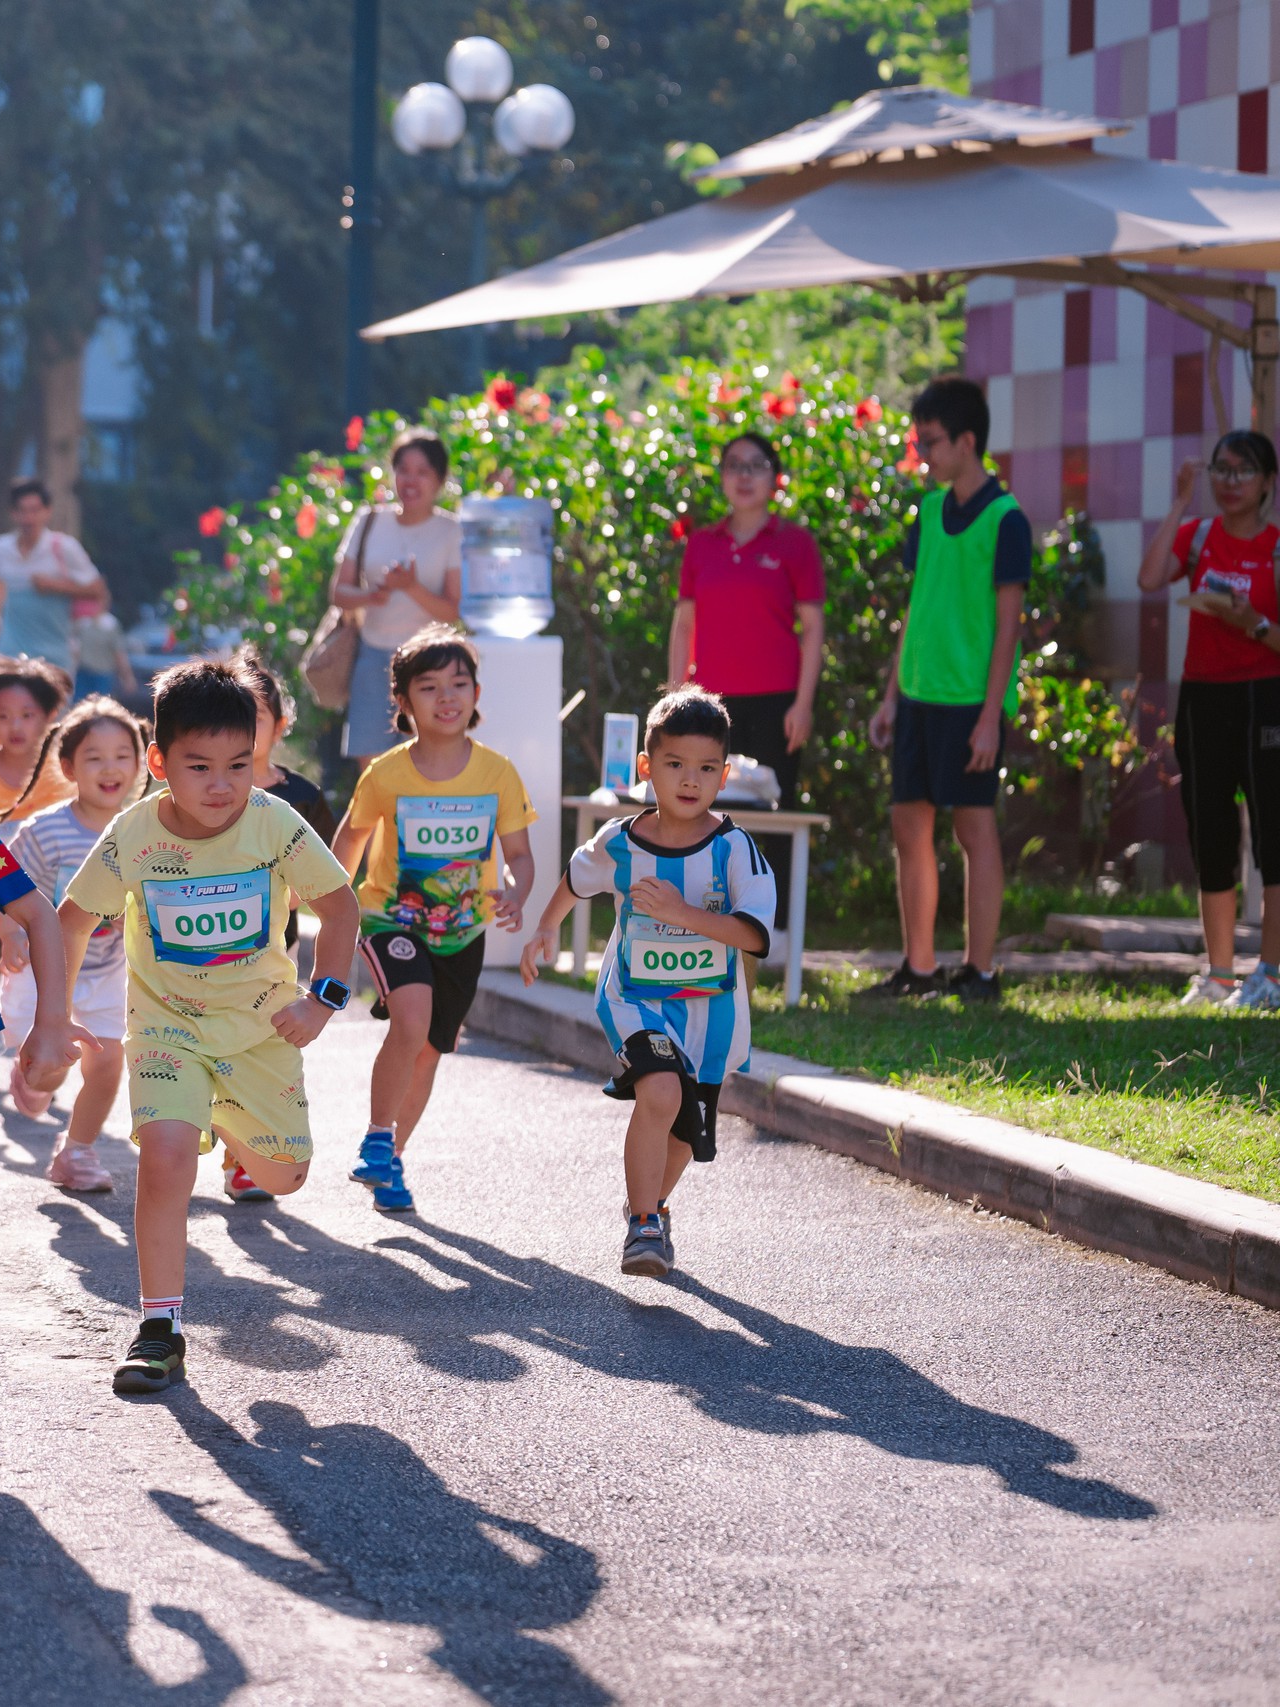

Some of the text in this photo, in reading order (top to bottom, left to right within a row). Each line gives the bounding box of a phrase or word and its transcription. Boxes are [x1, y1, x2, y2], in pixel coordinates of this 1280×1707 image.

[441, 804, 456, 812] FUN
[456, 804, 473, 812] RUN
[291, 825, 307, 845] MORE
[417, 825, 479, 844] 0030
[132, 842, 193, 864] TIME TO RELAX
[197, 886, 216, 896] FUN
[216, 884, 237, 895] RUN
[175, 909, 247, 936] 0010
[668, 928, 684, 936] FUN
[643, 949, 714, 971] 0002
[252, 991, 268, 1010] NEED
[164, 1026, 200, 1045] SNOOZE
[148, 1050, 158, 1058] TO
[161, 1052, 183, 1069] RELAX
[247, 1135, 278, 1149] CHOOSE
